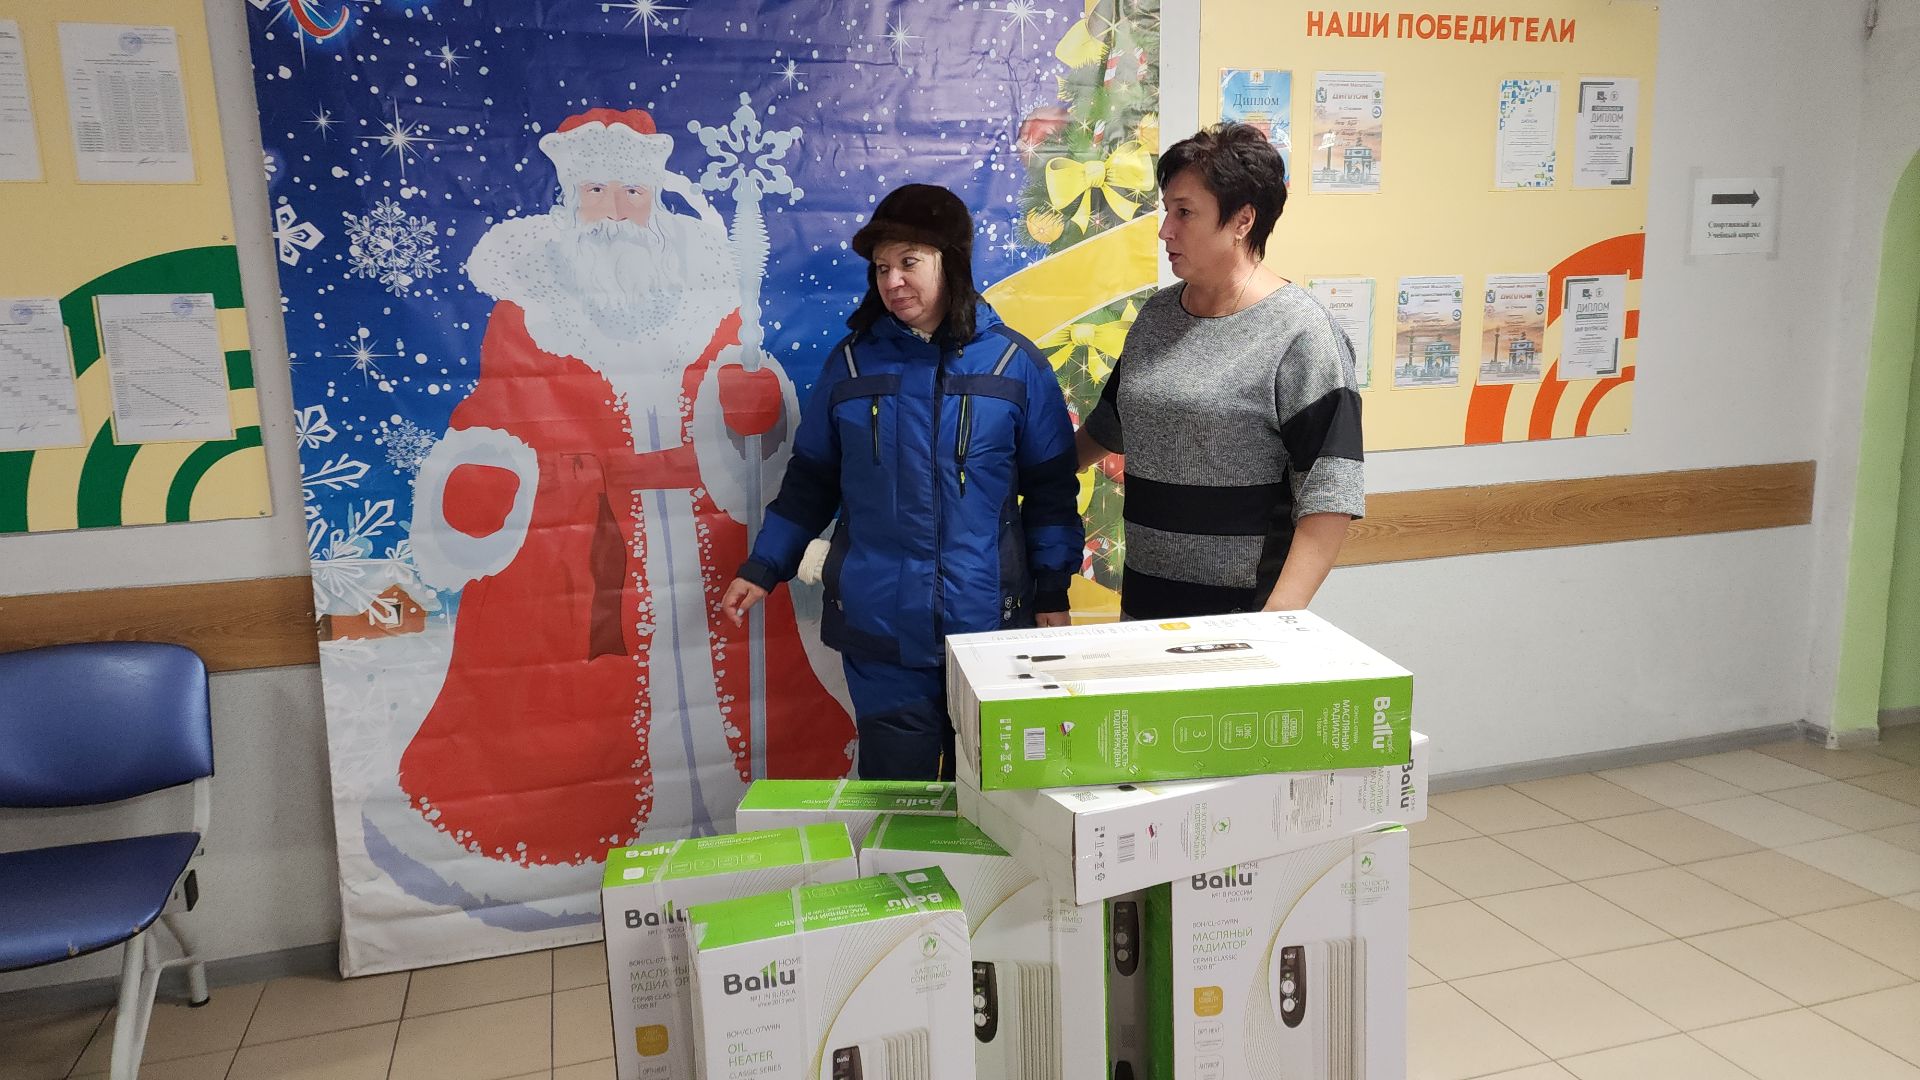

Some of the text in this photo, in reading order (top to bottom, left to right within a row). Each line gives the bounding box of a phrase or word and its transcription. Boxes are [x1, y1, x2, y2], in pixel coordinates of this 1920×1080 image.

[1307, 11, 1576, 43] НАШИ ПОБЕДИТЕЛИ
[1232, 93, 1279, 109] Диплом
[1590, 112, 1624, 123] ДИПЛОМ
[1576, 302, 1610, 313] ДИПЛОМ
[1331, 703, 1341, 749] РАДИАТОР
[1342, 699, 1351, 751] МАСЛЯНЫЙ
[1372, 696, 1394, 749] Ballu
[1121, 709, 1129, 768] БЕЗОПАСНОСТЬ
[1192, 729, 1206, 738] 3
[1400, 759, 1415, 809] Ballu
[1191, 864, 1253, 890] Ballu
[774, 914, 819, 927] РАДАТОР
[1192, 927, 1253, 943] МАСЛЯНЫЙ
[1193, 940, 1247, 953] РАДИАТОР
[1213, 954, 1237, 963] CLASSIC
[631, 976, 689, 993] РАДИАОР
[723, 960, 796, 995] Ballu
[728, 1042, 748, 1055] OIL
[728, 1050, 773, 1068] HEATER
[729, 1064, 782, 1080] CLASSIC SERIES
